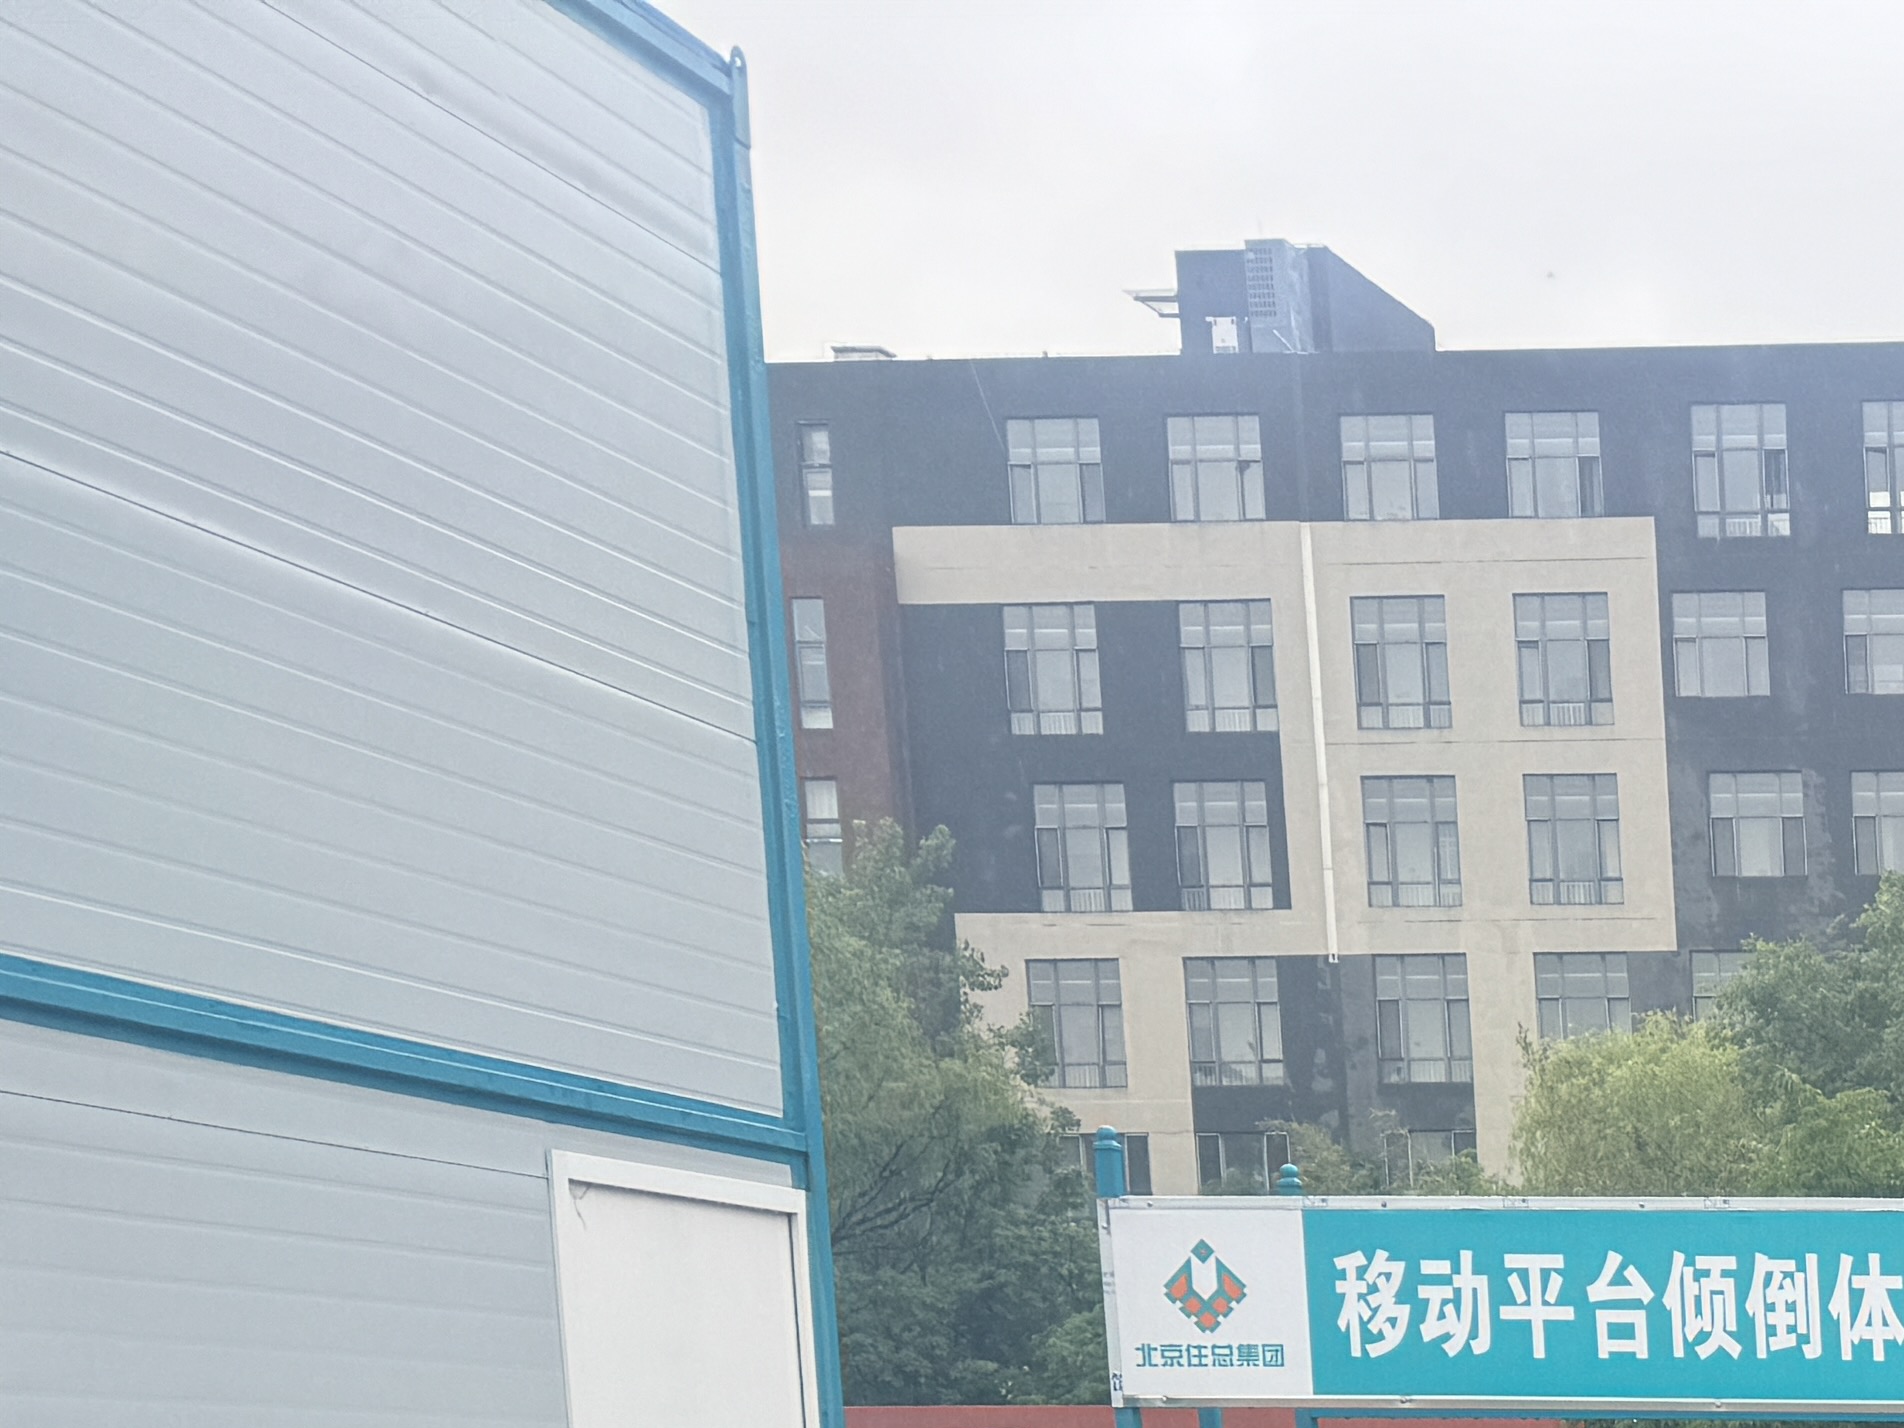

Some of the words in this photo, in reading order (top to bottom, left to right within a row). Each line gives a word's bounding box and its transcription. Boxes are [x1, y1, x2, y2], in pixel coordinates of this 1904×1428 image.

[1134, 1343, 1285, 1368] 北京住总集团
